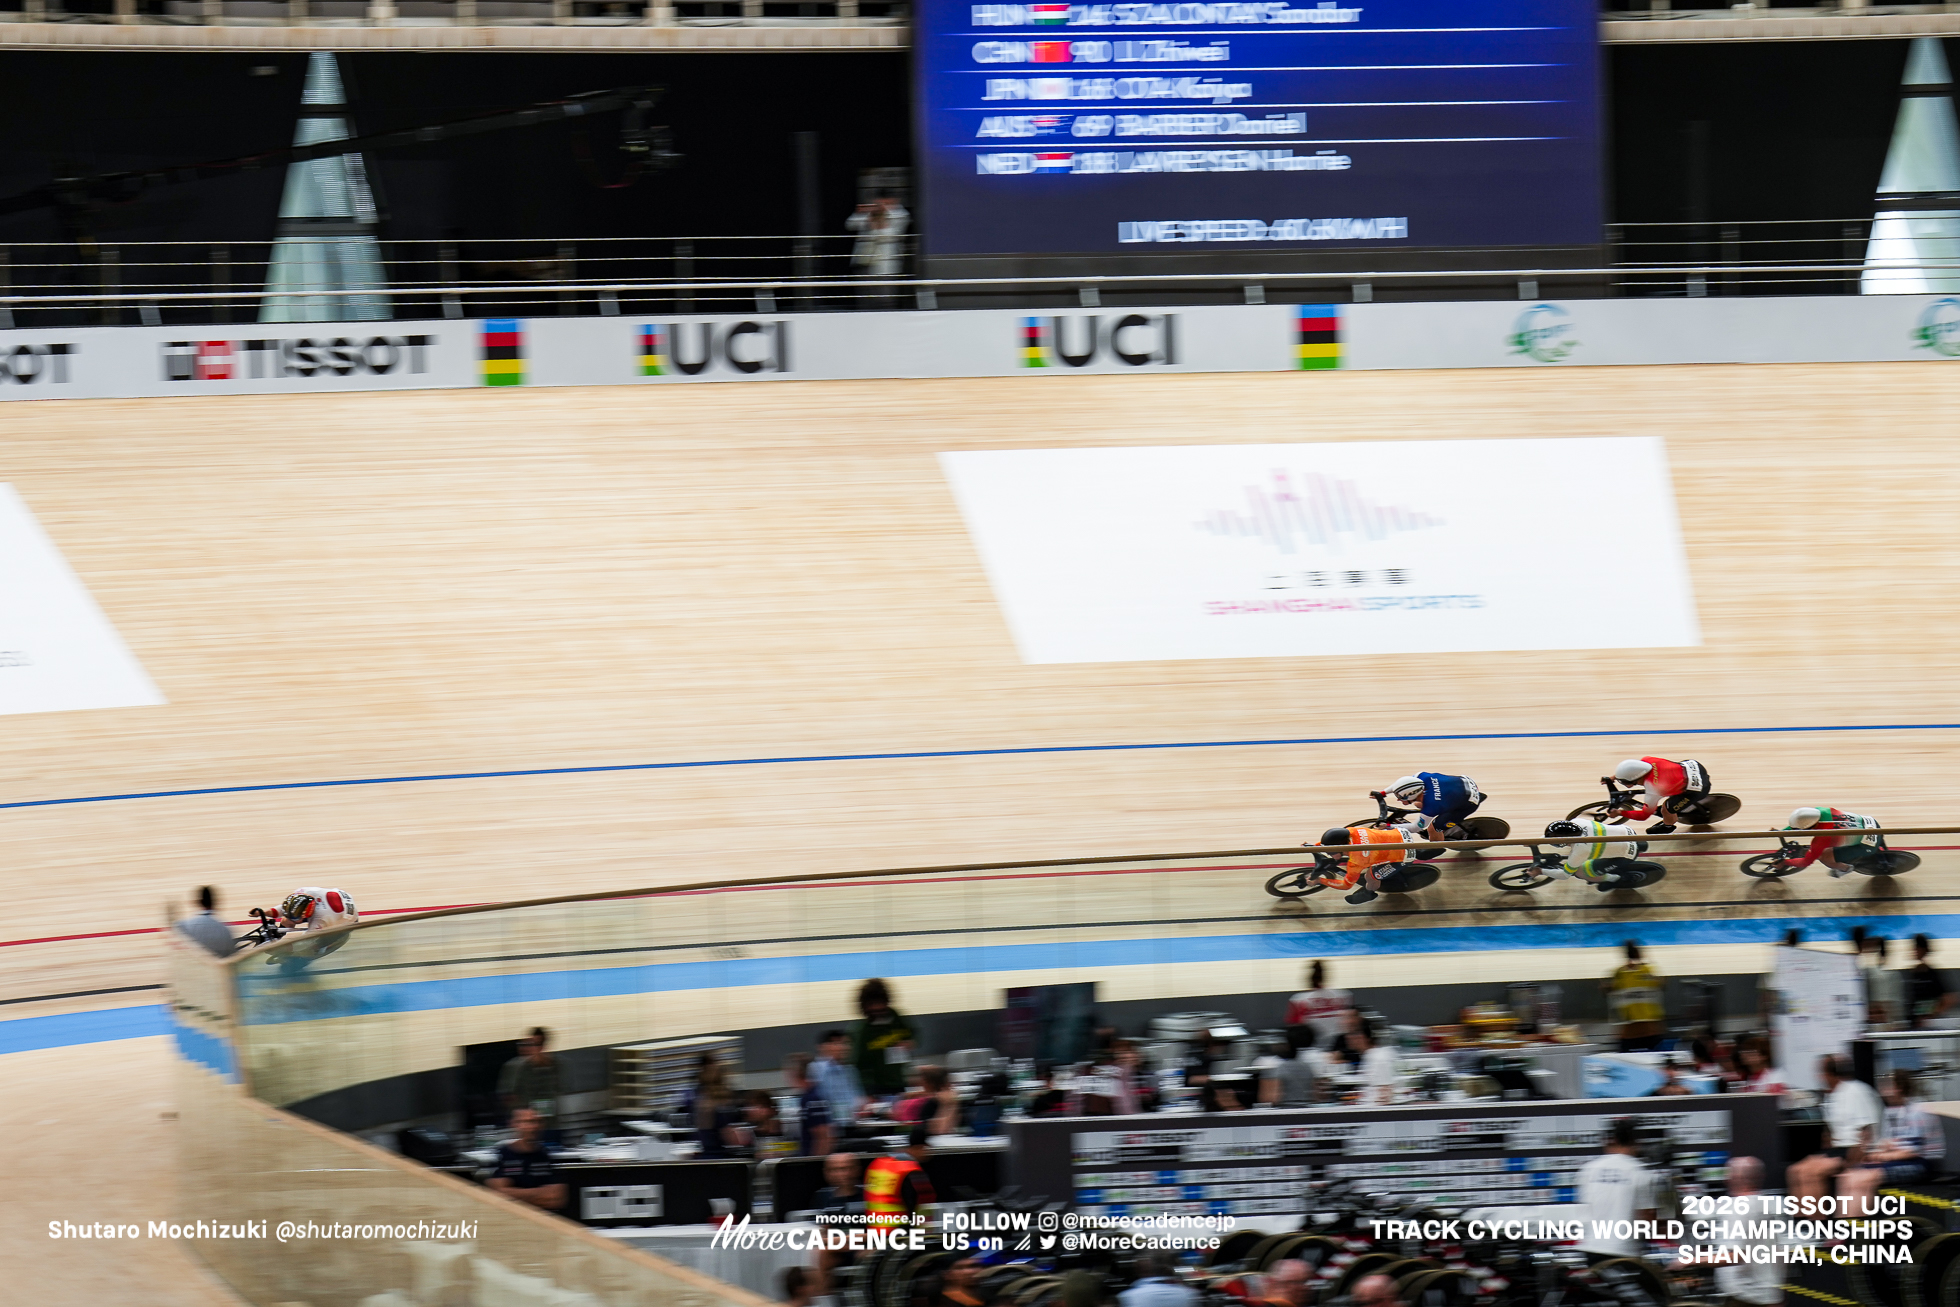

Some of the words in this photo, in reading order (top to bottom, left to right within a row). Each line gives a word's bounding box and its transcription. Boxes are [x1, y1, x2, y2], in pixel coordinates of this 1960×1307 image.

[234, 334, 437, 380] TISSOT
[666, 320, 794, 376] UCI
[1050, 313, 1183, 368] UCI
[1430, 776, 1442, 801] FRANCE
[1651, 762, 1659, 785] CHINA
[1673, 797, 1690, 812] CHINA
